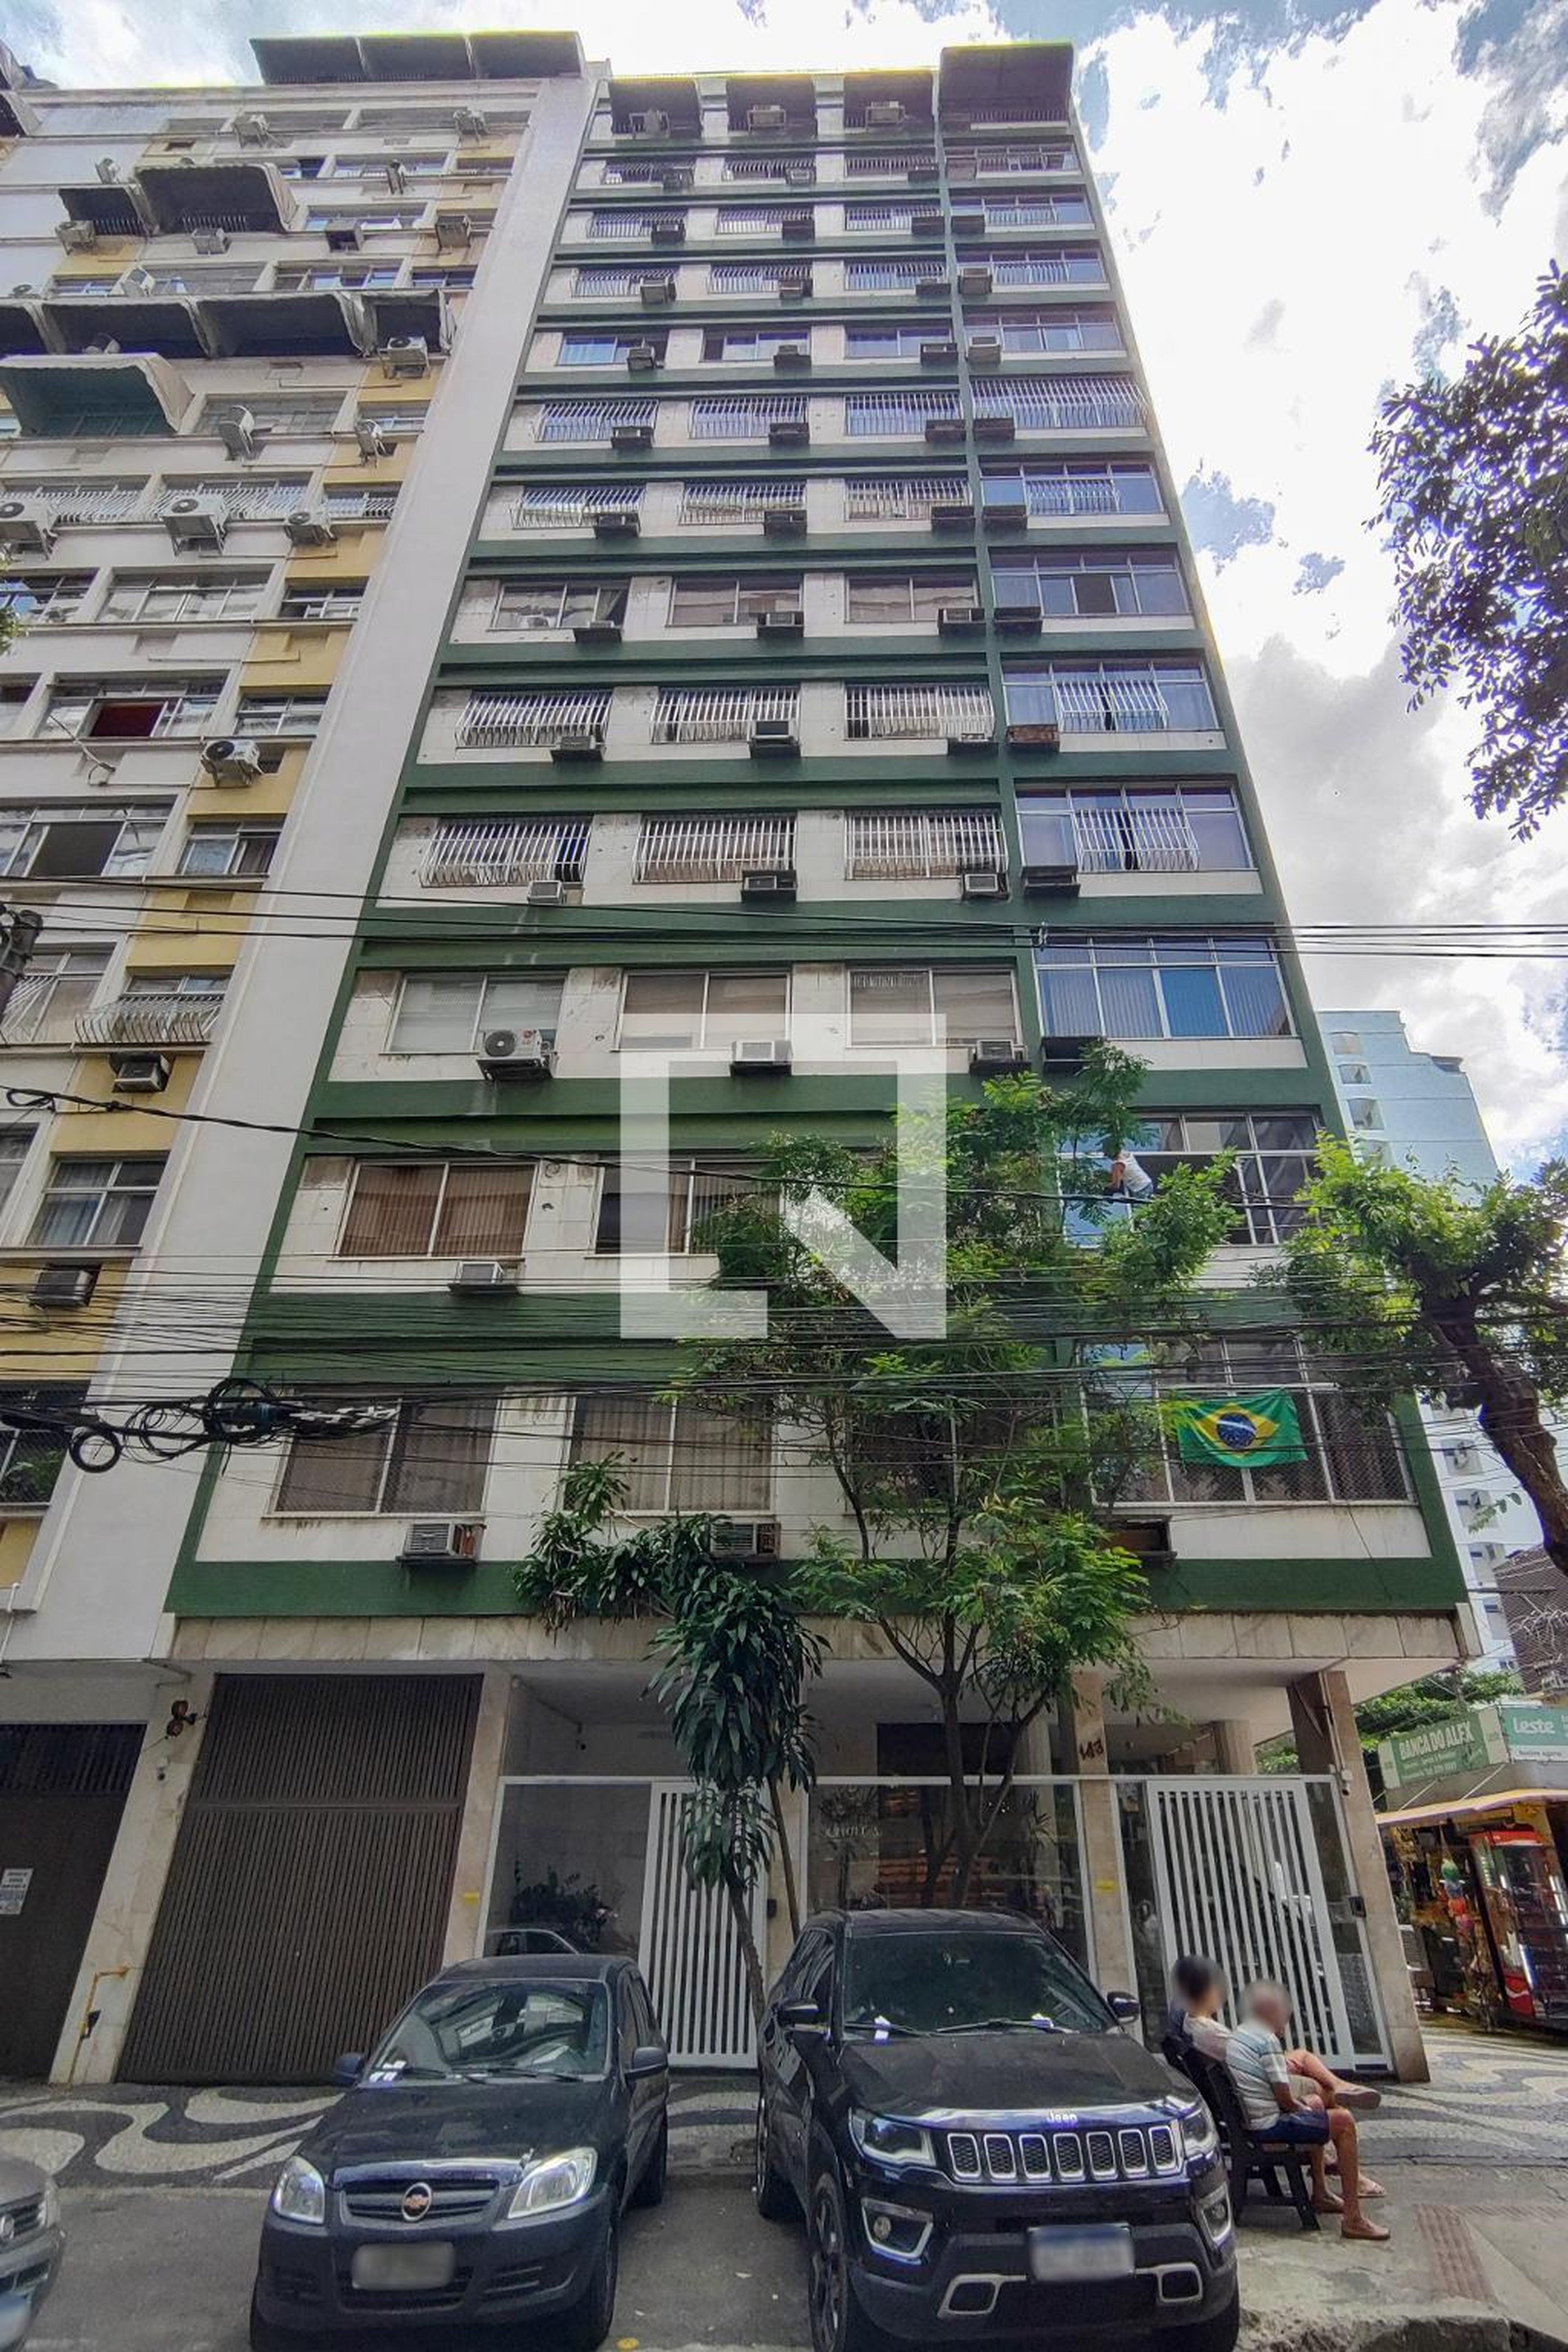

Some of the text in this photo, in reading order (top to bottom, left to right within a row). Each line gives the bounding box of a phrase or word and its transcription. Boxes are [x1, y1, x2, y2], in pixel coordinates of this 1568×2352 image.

[1513, 1717, 1555, 1734] Leste
[1399, 1734, 1432, 1760] BANCA
[1430, 1729, 1446, 1752] DO
[1445, 1720, 1475, 1748] ALEX
